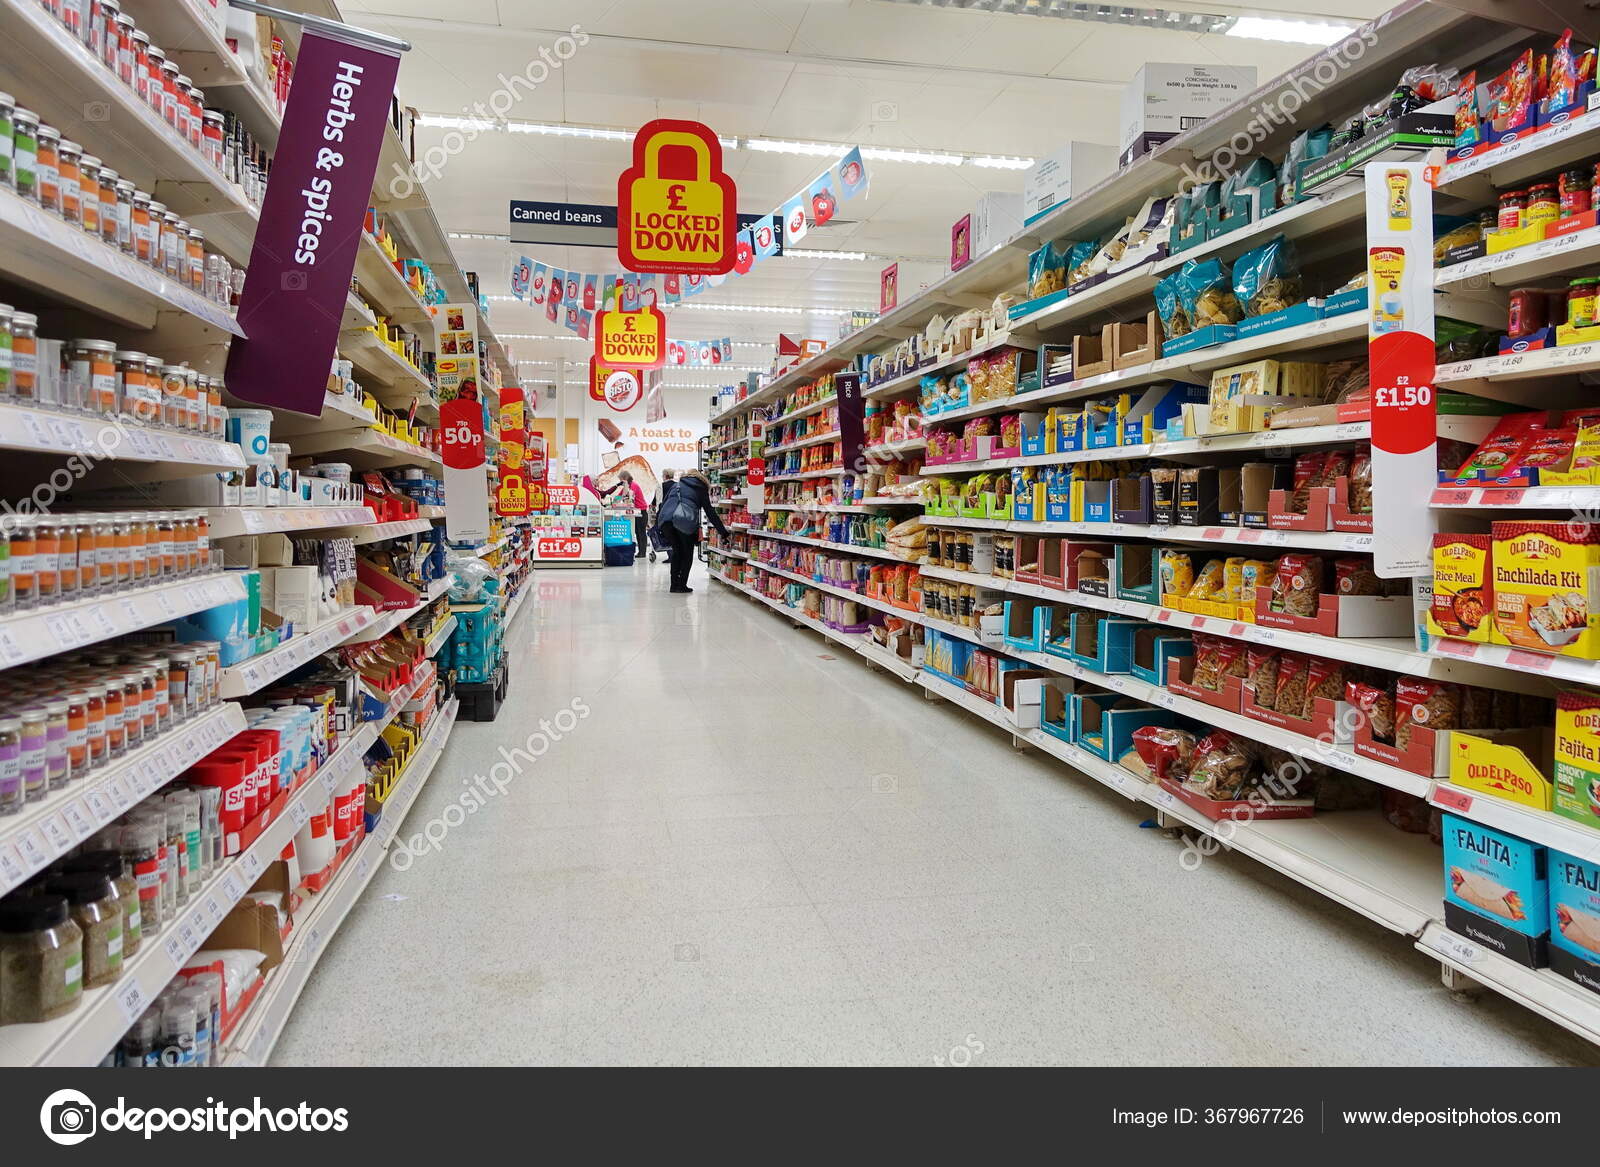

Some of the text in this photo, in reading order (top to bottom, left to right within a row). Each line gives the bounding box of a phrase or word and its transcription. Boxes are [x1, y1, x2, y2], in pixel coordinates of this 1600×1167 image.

[294, 60, 364, 264] Herbs & spices
[666, 184, 687, 211] £
[512, 207, 602, 224] Canned beans
[635, 212, 720, 232] LOCKED
[635, 231, 720, 253] DOWN
[624, 316, 636, 331] £
[606, 333, 656, 344] LOCKED
[605, 344, 655, 356] DOWN
[1397, 376, 1409, 385] £2
[844, 381, 852, 398] Rice
[1375, 387, 1431, 406] £1.50
[445, 427, 482, 446] 50p
[629, 427, 692, 438] A toast to
[640, 442, 659, 452] no
[540, 542, 580, 553] £11.49
[1510, 540, 1561, 558] OLD EL PASO
[1436, 571, 1476, 584] Rice Meal
[1497, 567, 1582, 588] Enchilada Kit
[1498, 594, 1526, 602] CHEESY
[1498, 604, 1523, 612] BAKED
[1575, 714, 1590, 728] OLD
[1559, 736, 1594, 761] Fajita
[1558, 762, 1586, 780] SMOKY
[1558, 772, 1574, 786] BBQ
[1468, 764, 1532, 796] OLD EL PASO
[1457, 829, 1511, 867] FAJITA
[1473, 928, 1506, 950] Sainsbury's
